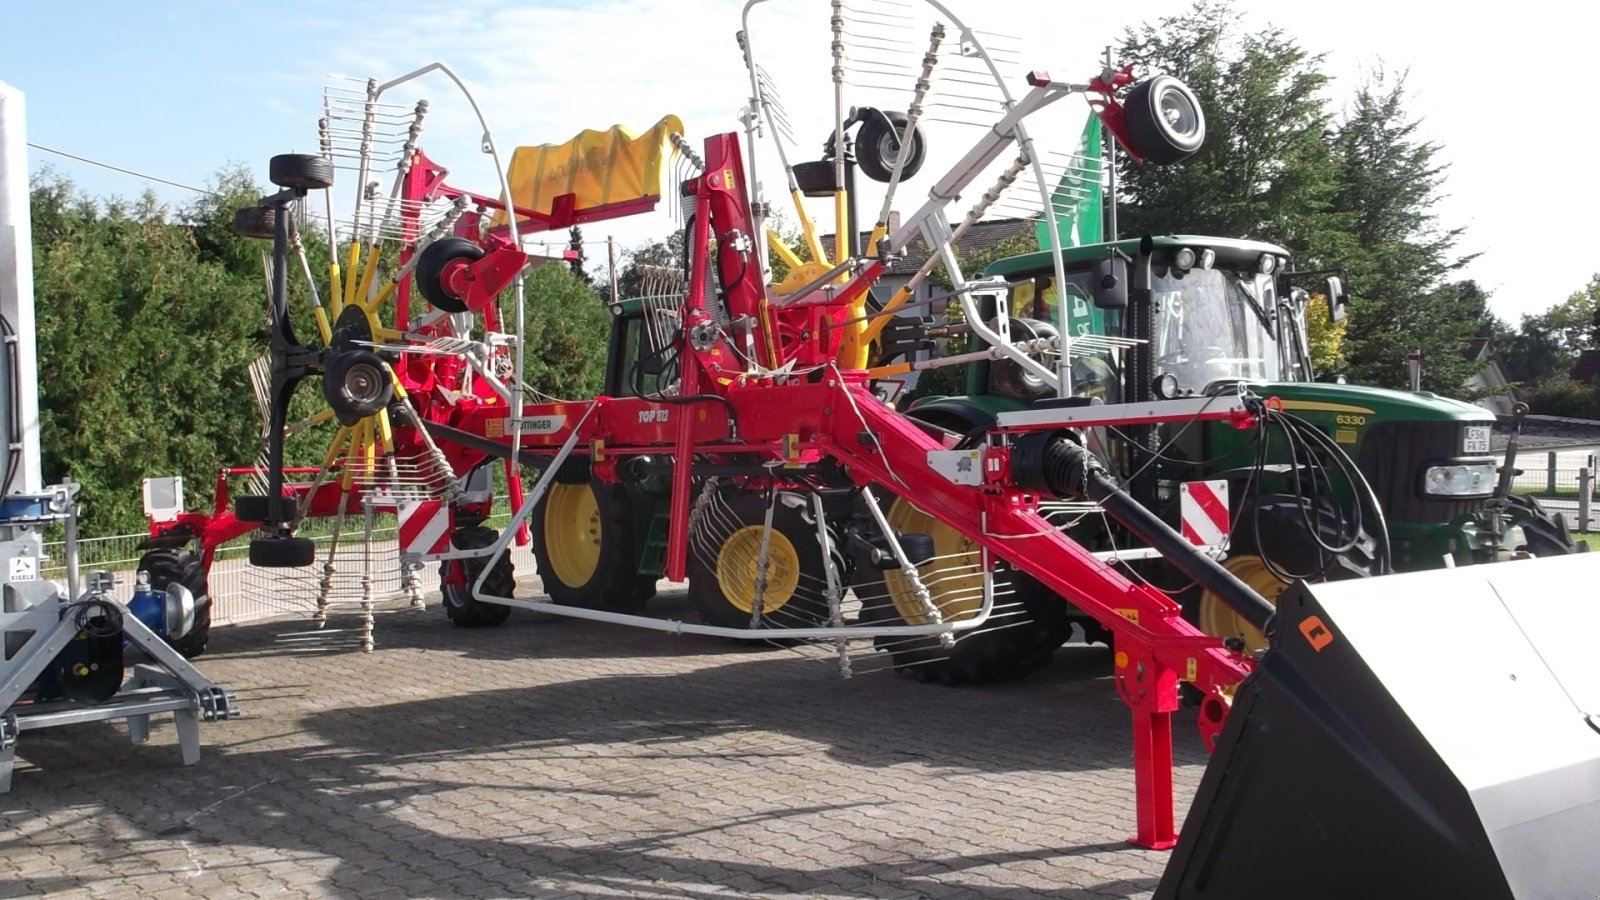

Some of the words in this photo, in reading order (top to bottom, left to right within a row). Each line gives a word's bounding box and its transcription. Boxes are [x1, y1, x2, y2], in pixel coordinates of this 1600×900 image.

[638, 410, 656, 423] TOP
[1336, 415, 1366, 425] 6330
[519, 419, 552, 431] TTINGER
